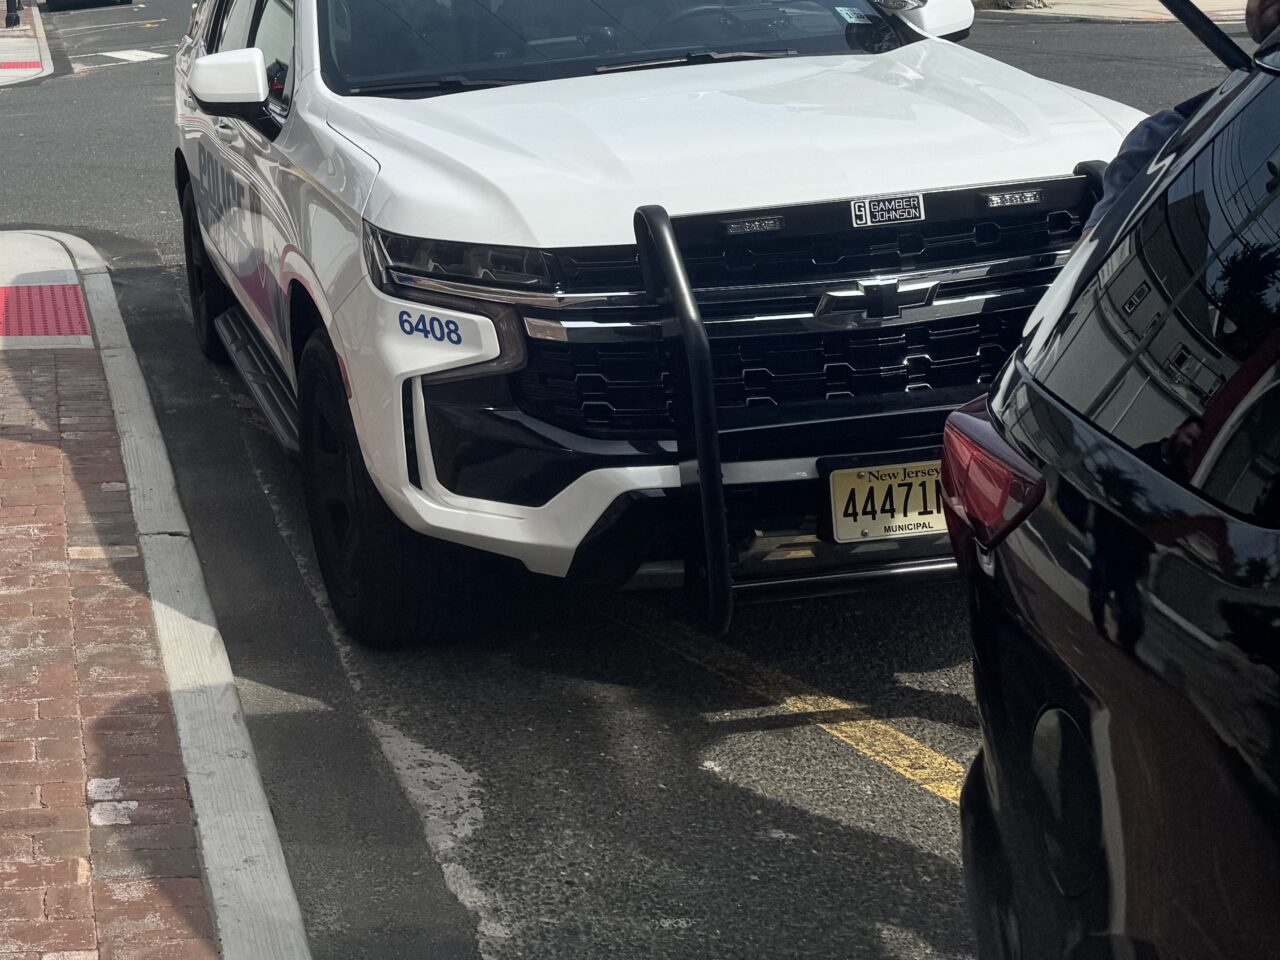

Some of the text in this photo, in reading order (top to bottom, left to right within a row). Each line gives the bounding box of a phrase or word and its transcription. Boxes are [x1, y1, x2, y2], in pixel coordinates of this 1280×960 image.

[871, 197, 918, 212] GAMBER
[872, 208, 919, 222] JOHNSON
[398, 310, 463, 345] 6408
[868, 467, 941, 482] New Jersey
[883, 521, 934, 533] MUNICIPAL
